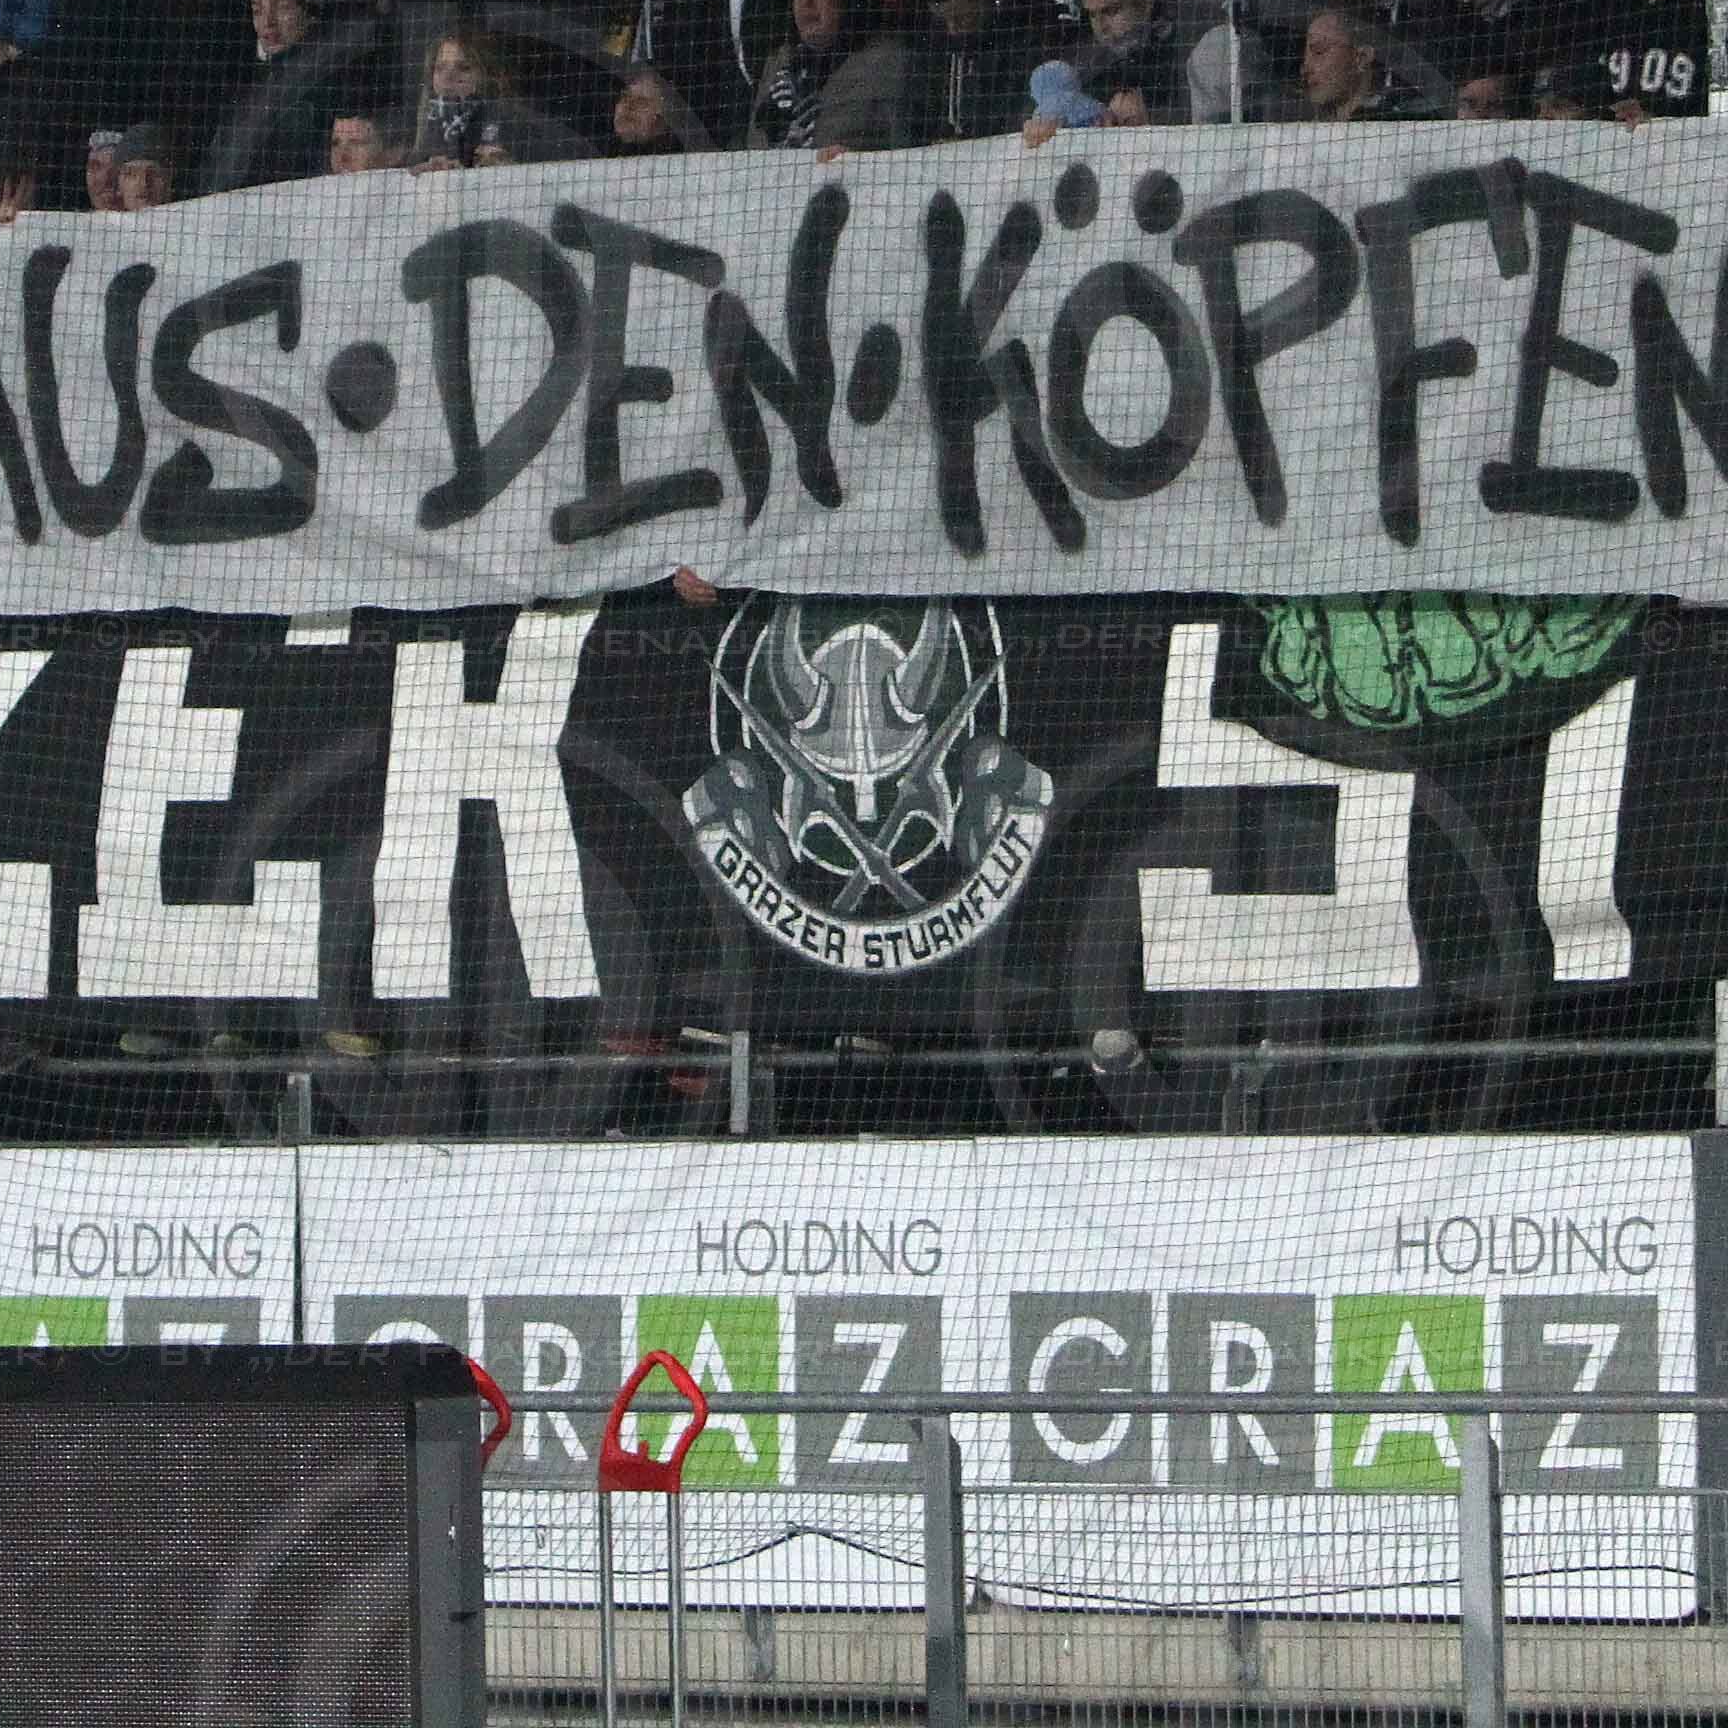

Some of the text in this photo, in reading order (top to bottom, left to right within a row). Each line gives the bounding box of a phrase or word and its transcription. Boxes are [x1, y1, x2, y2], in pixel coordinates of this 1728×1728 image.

[1598, 47, 1696, 100] 909
[401, 181, 852, 545] DEN
[712, 819, 1032, 969] GRAZER STURMFLUT
[31, 1221, 263, 1279] HOLDING
[695, 1217, 944, 1277] HOLDING
[1395, 1214, 1659, 1277] HOLDING
[1025, 1316, 1625, 1470] GRAZ
